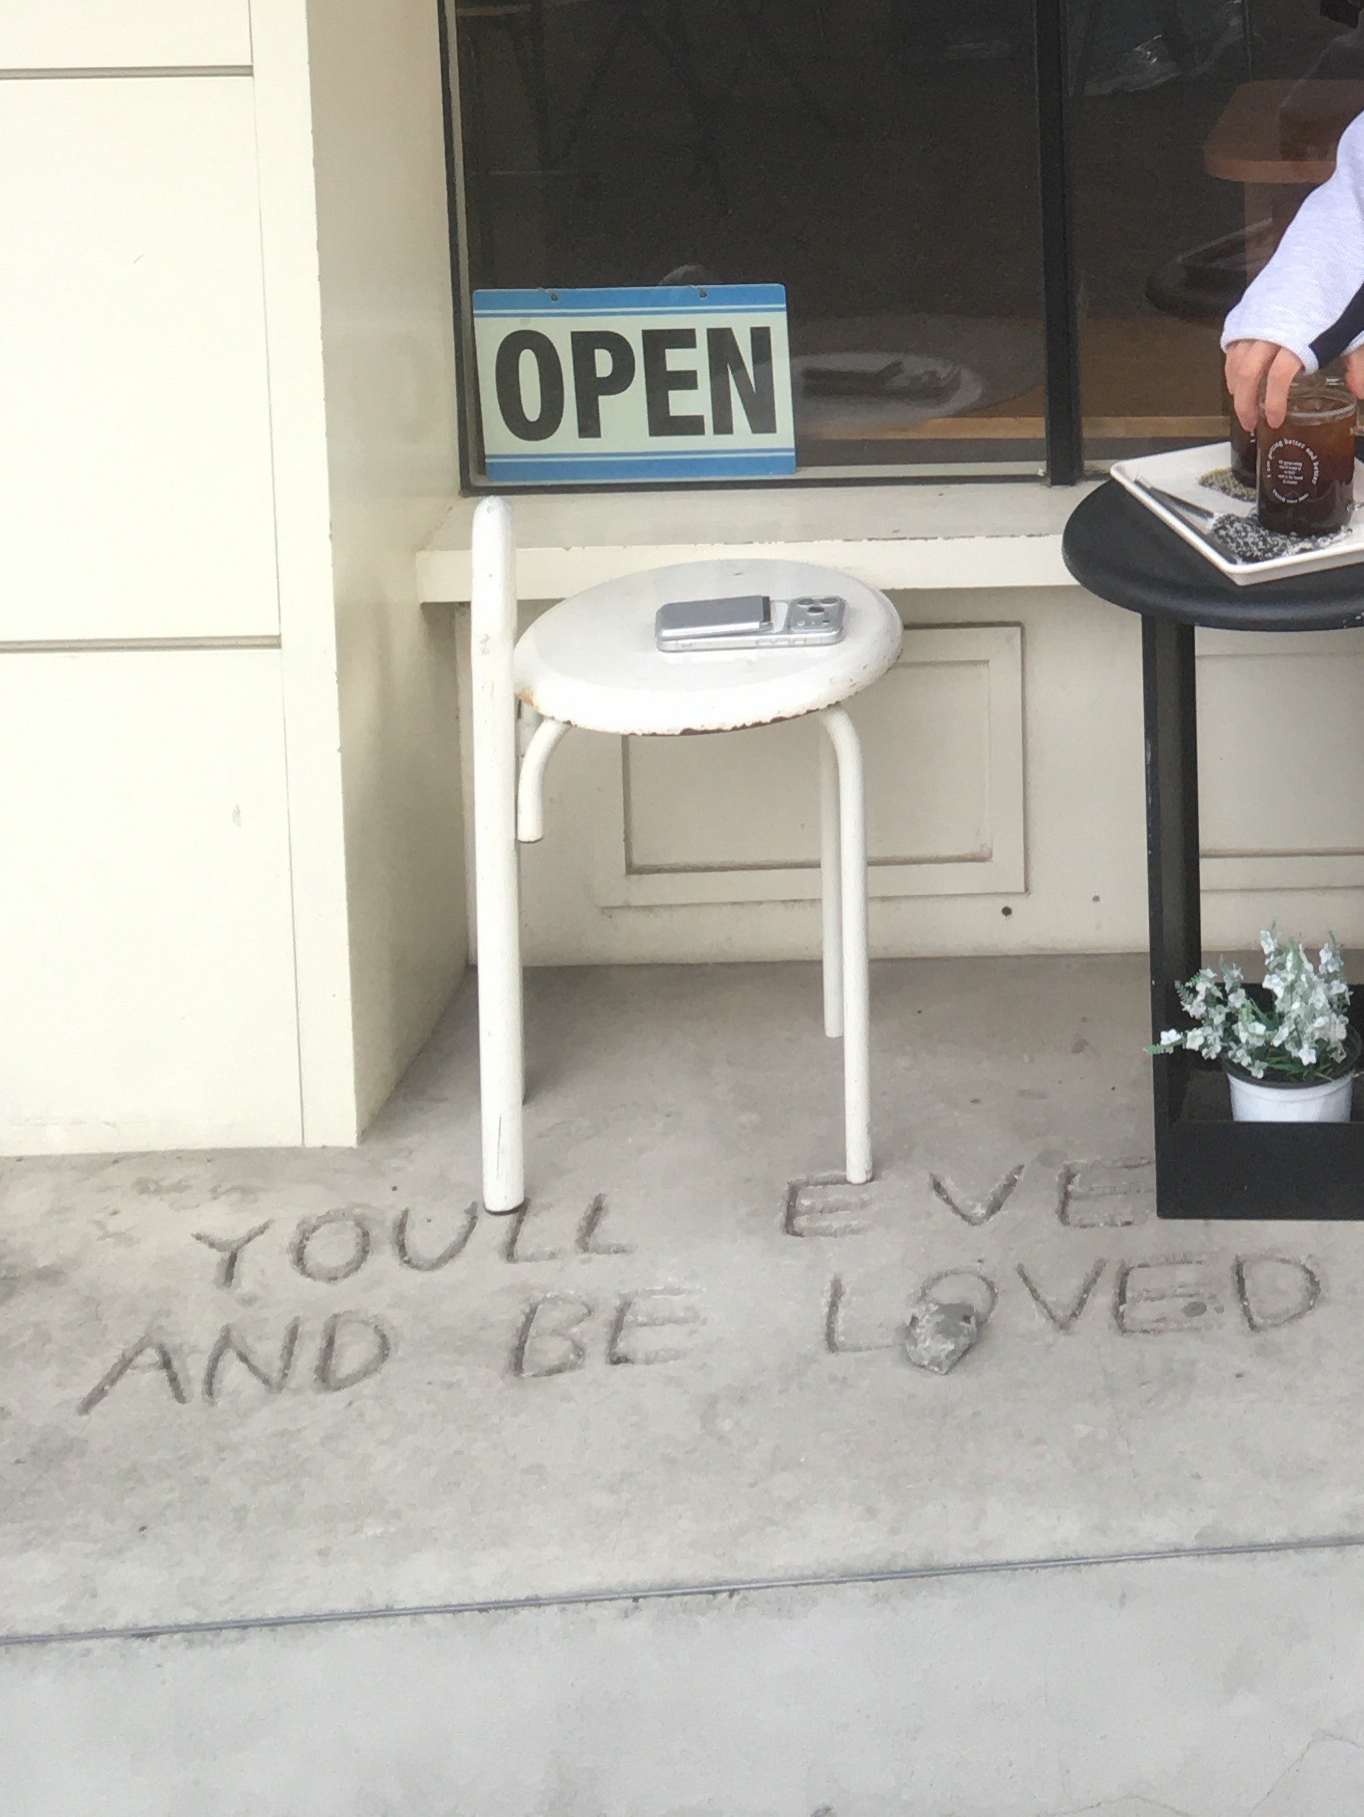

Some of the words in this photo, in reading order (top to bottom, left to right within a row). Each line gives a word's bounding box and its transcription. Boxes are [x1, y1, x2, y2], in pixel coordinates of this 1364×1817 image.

[495, 326, 777, 442] OPEN
[190, 1191, 637, 1290] YOULL
[75, 1309, 391, 1416] AND
[511, 1284, 704, 1381] BE
[824, 1255, 1322, 1355] LOVED
